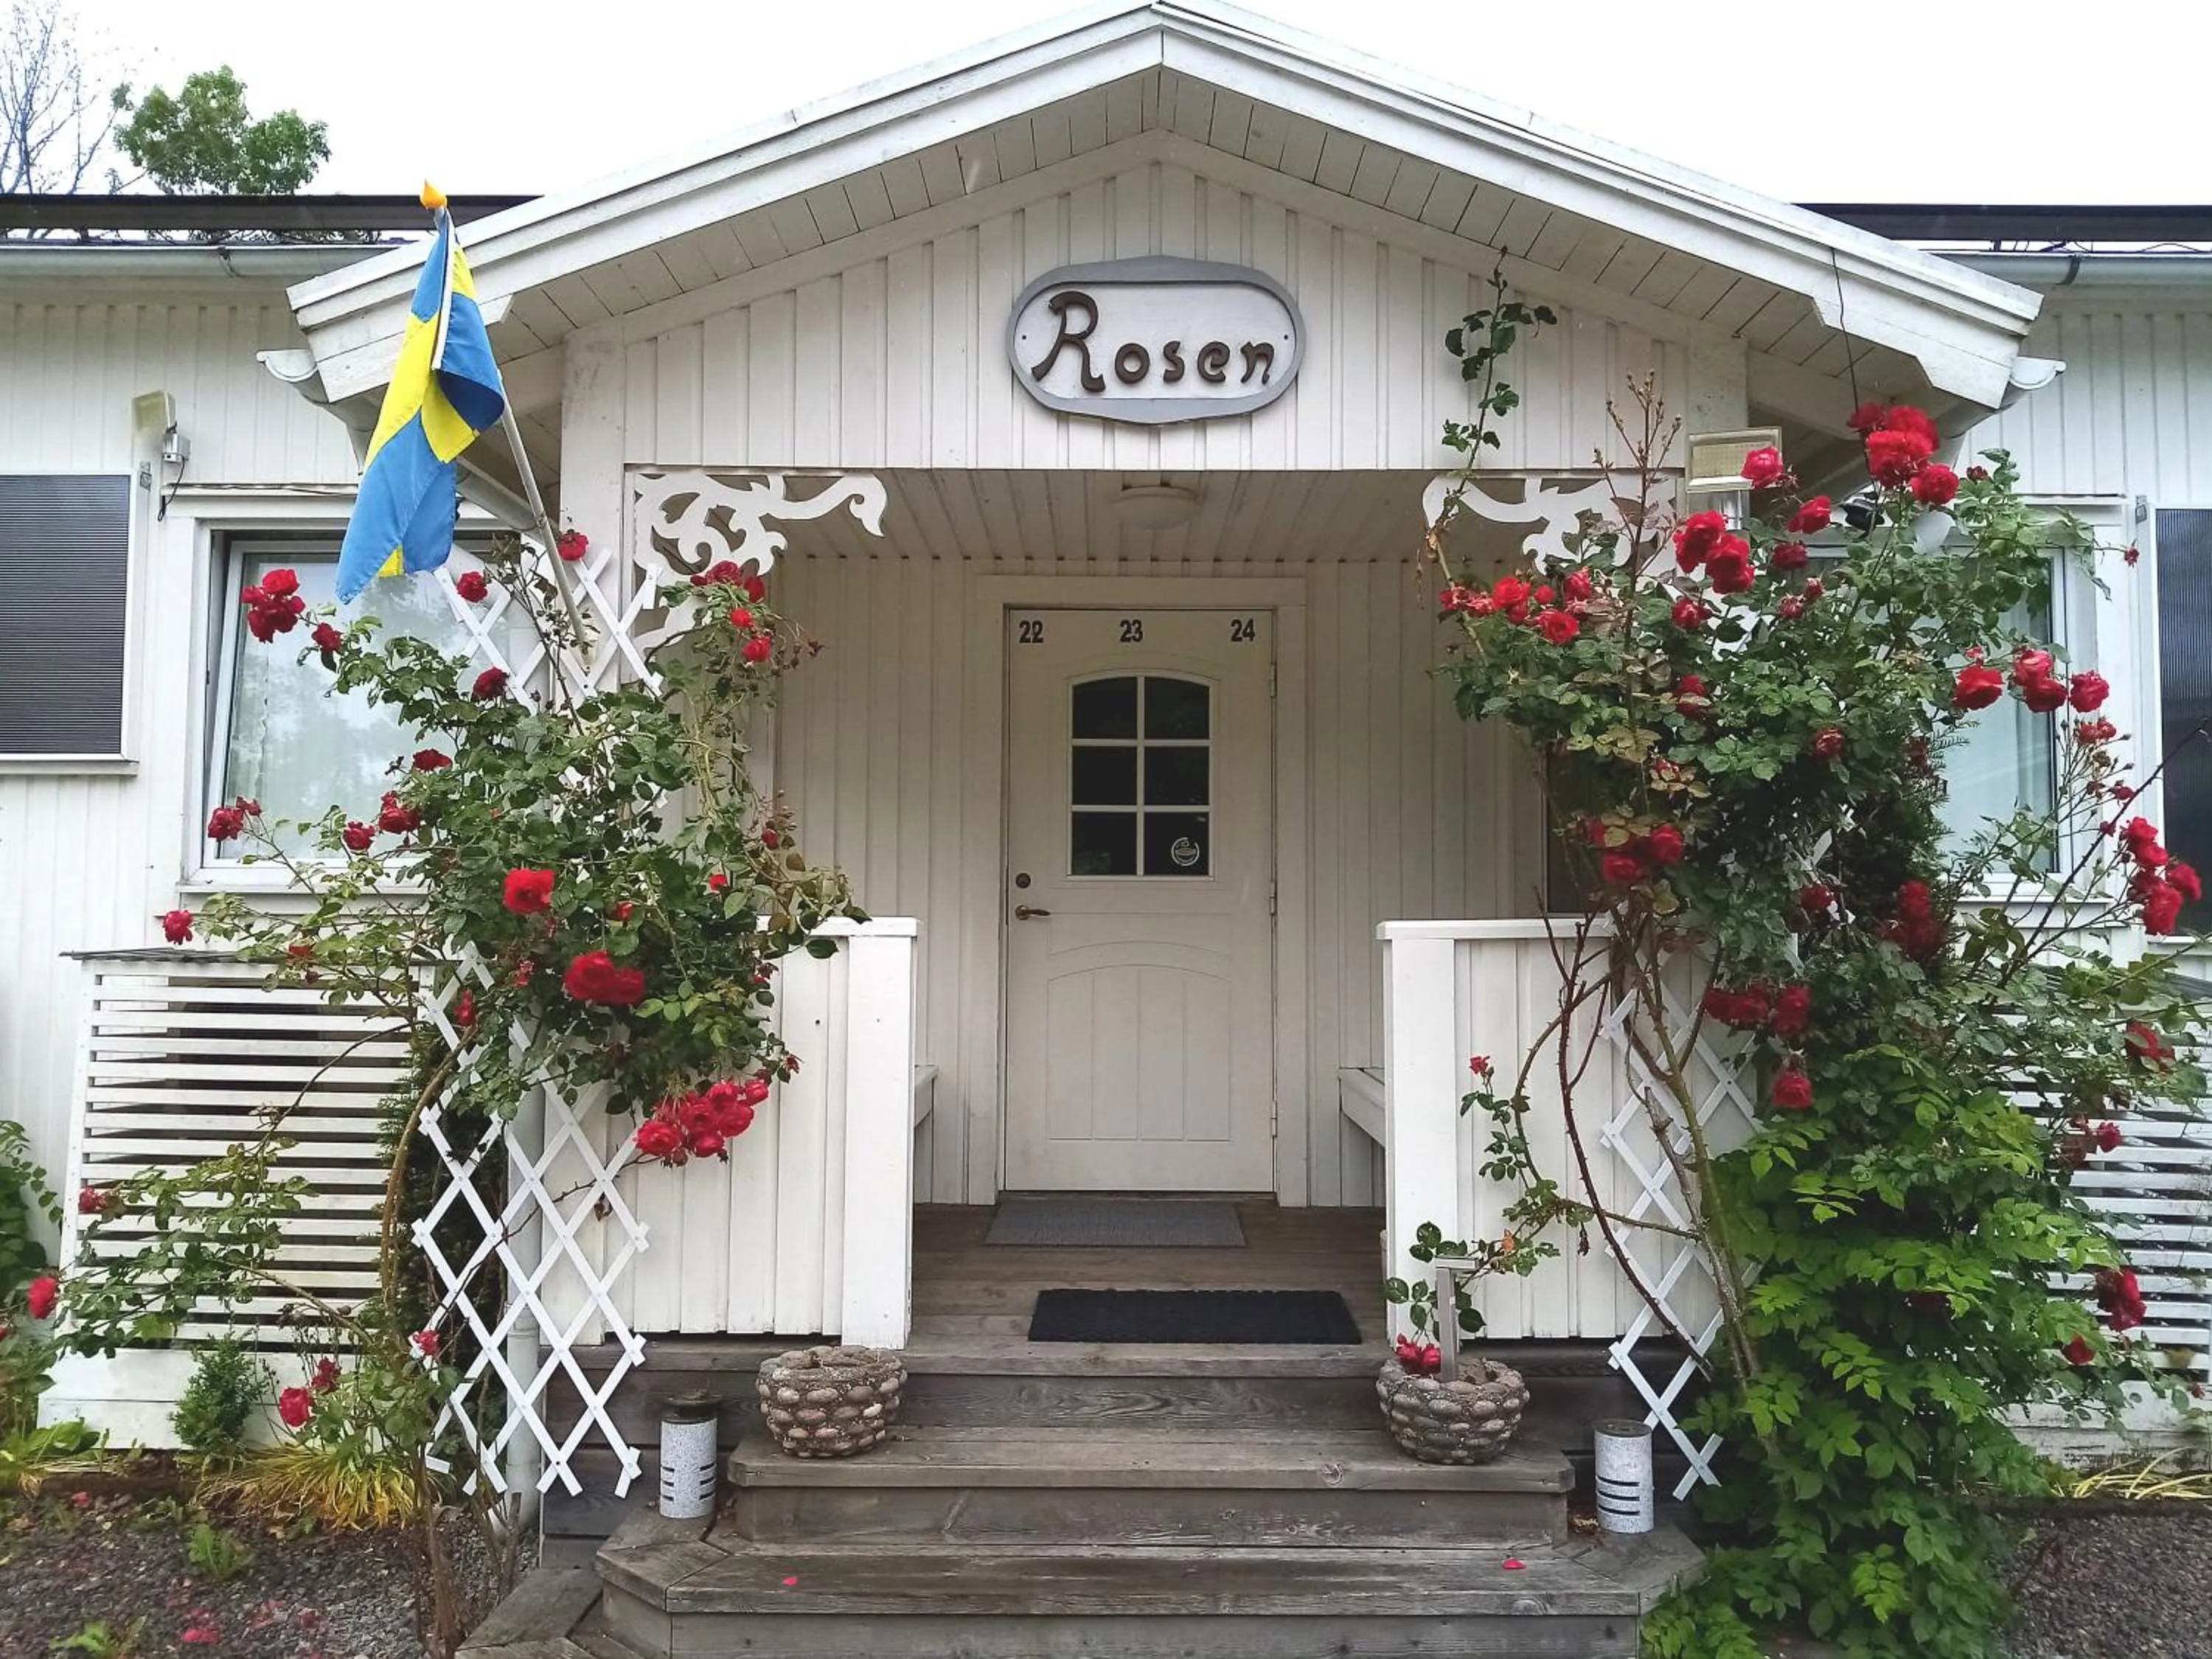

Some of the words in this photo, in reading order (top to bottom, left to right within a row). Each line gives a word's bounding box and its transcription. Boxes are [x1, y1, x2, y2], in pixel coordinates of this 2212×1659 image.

[1031, 290, 1276, 394] Rosen
[1018, 620, 1044, 644] 22
[1119, 619, 1144, 643] 23
[1230, 618, 1256, 642] 24
